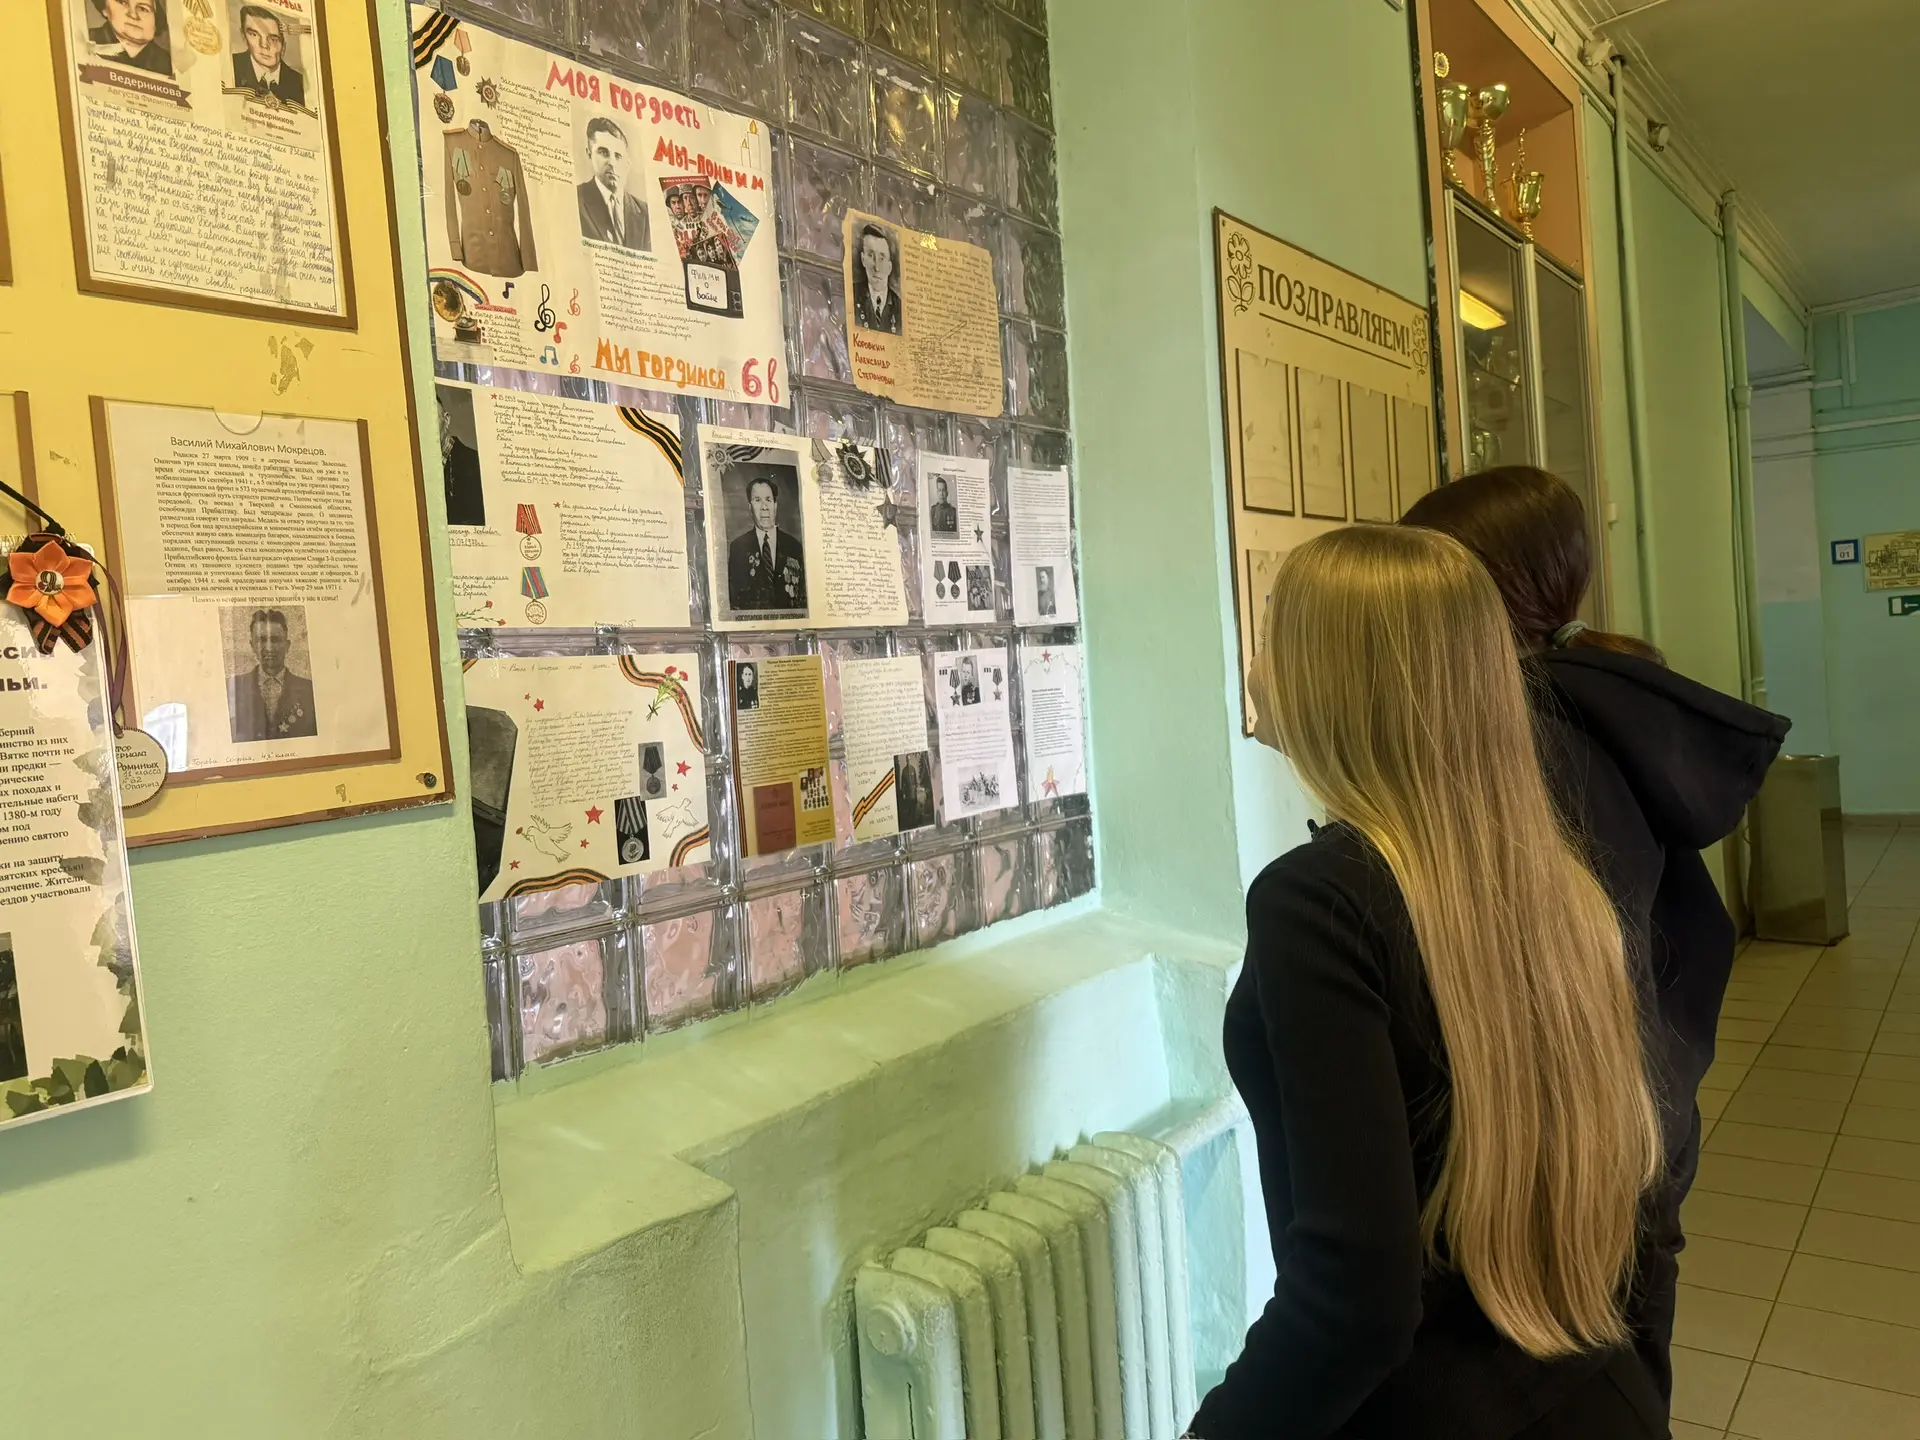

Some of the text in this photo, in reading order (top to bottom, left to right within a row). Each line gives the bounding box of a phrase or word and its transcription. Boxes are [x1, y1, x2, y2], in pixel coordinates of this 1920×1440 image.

[110, 72, 182, 98] Ведерникова
[249, 107, 294, 126] Ведерников
[1258, 264, 1410, 358] ПОЗДРАВЛЯЕМ!
[170, 436, 326, 456] Василий Михайлович Мокрецов.
[0, 752, 29, 760] Вятке
[32, 750, 60, 758] почти
[12, 762, 46, 773] предки
[12, 785, 52, 796] походах
[46, 794, 78, 804] набеги
[4, 807, 62, 820] 1380-м году
[12, 824, 30, 832] под
[32, 830, 69, 841] святого
[28, 854, 64, 866] защиту
[41, 864, 84, 876] крестьян
[46, 876, 84, 887] Жители
[0, 886, 90, 906] ездов участвовали
